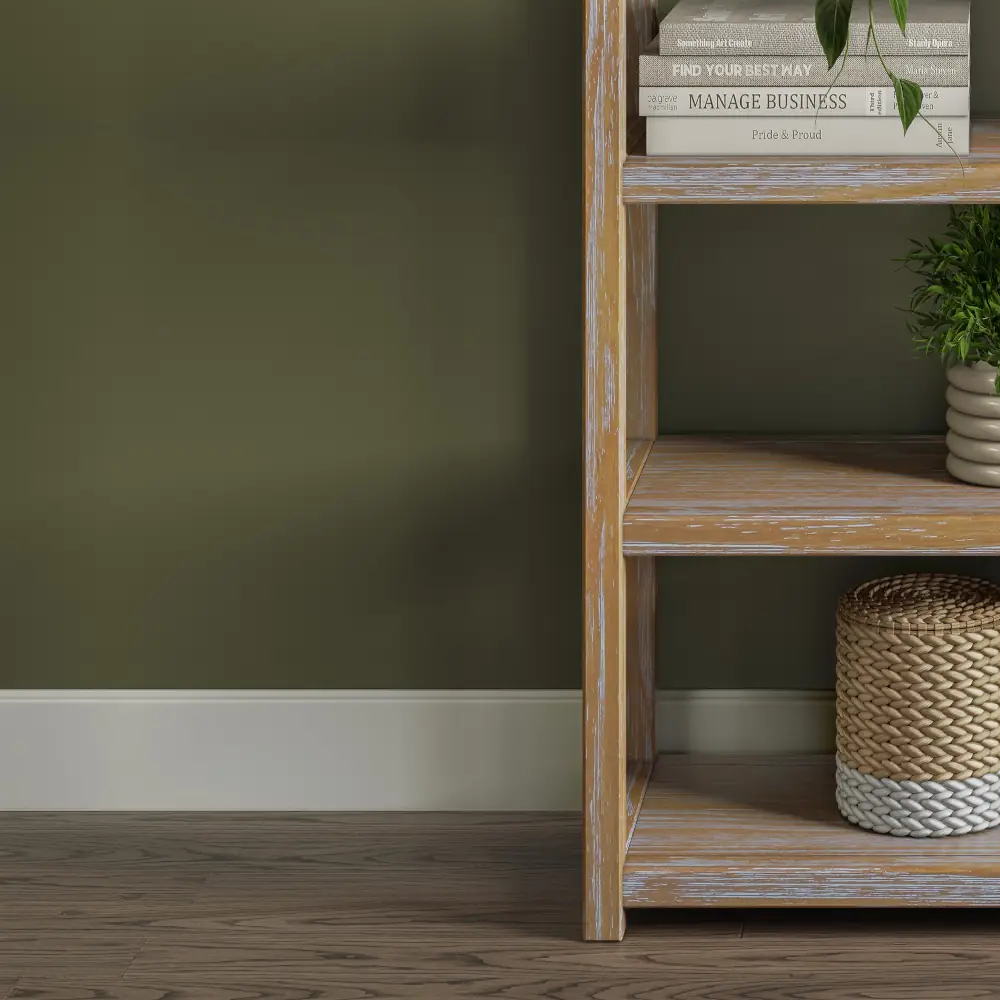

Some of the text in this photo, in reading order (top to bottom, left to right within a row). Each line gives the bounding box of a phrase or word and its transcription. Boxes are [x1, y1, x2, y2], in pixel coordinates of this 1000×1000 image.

[677, 38, 752, 48] Something Art Create
[932, 39, 953, 48] Opera
[672, 64, 812, 76] FIND YOUR BEST WAY
[934, 90, 939, 98] &
[688, 94, 847, 110] MANAGE BUSINESS
[752, 130, 822, 140] Pride & Proud
